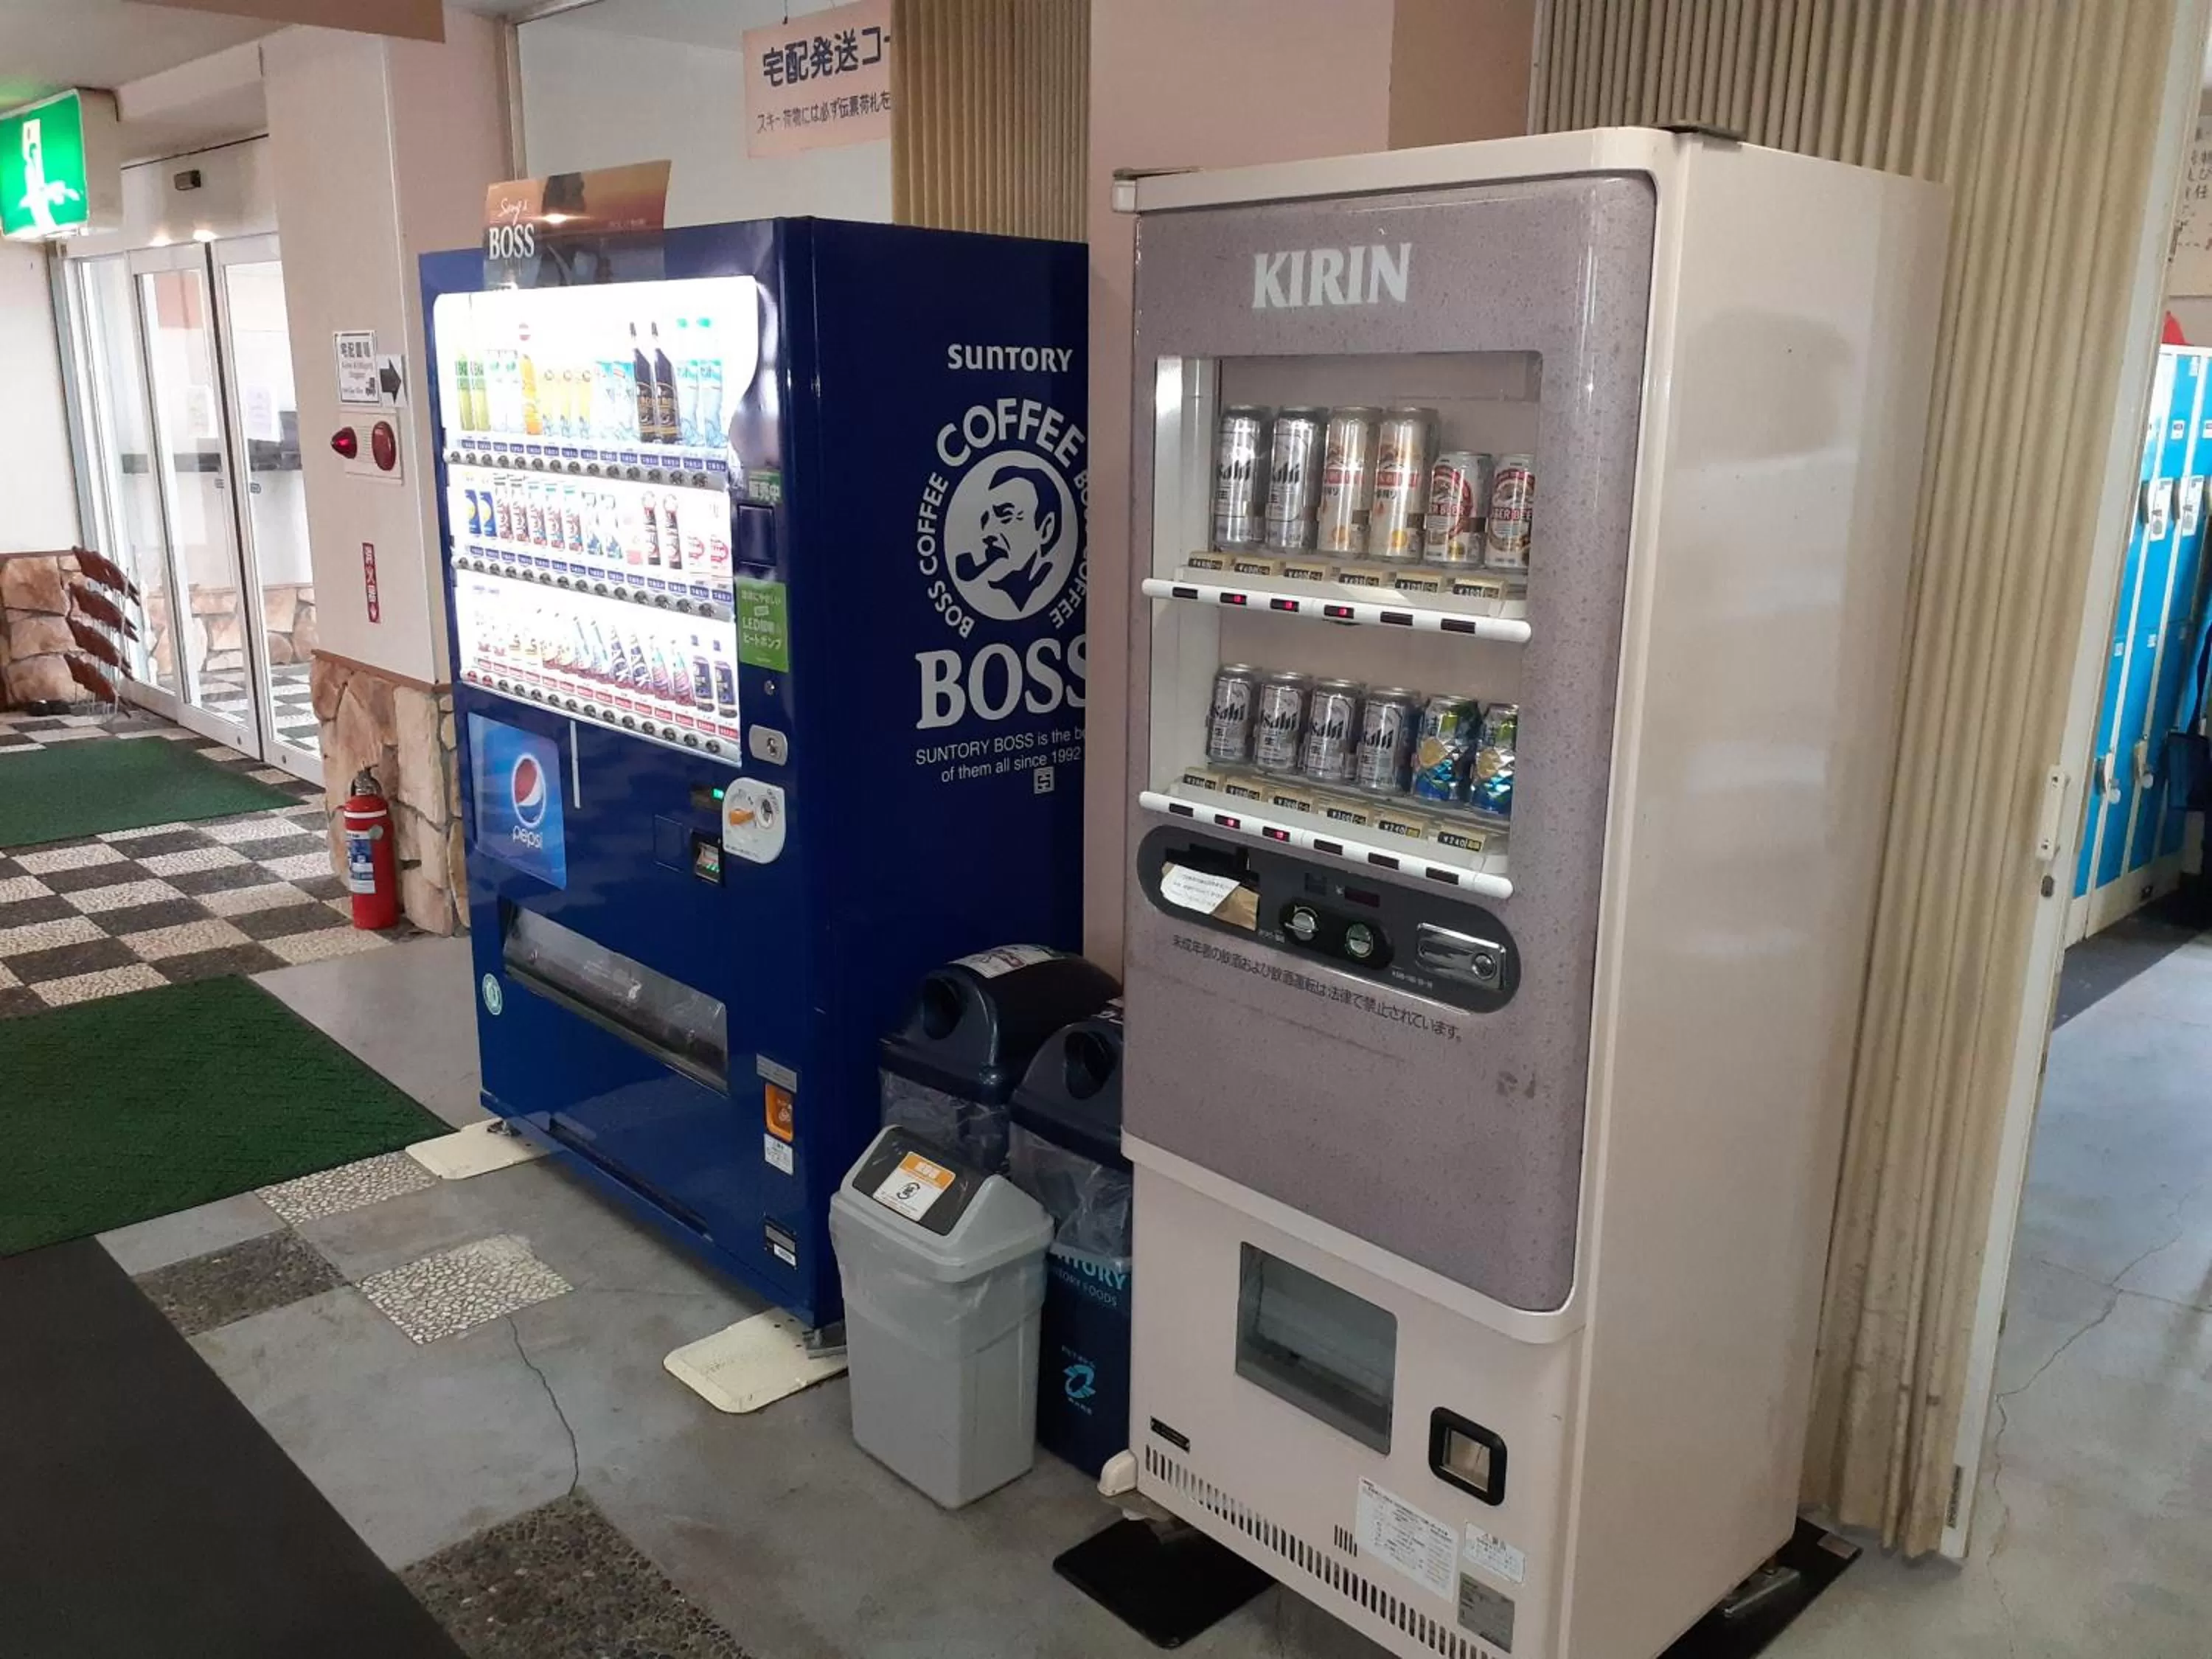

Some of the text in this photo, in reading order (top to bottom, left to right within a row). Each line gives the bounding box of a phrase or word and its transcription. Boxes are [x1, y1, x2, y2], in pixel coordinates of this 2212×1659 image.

[489, 223, 535, 260] BOSS
[1252, 242, 1412, 309] KIRIN
[936, 397, 1086, 468] COFFEE
[917, 472, 976, 639] BOSS COFFEE
[915, 739, 991, 765] SUNTORY
[993, 731, 1034, 754] BOSS
[1037, 730, 1048, 746] is
[1051, 727, 1072, 744] the
[941, 745, 1082, 783] of them all since 1992
[512, 825, 543, 849] pepsi
